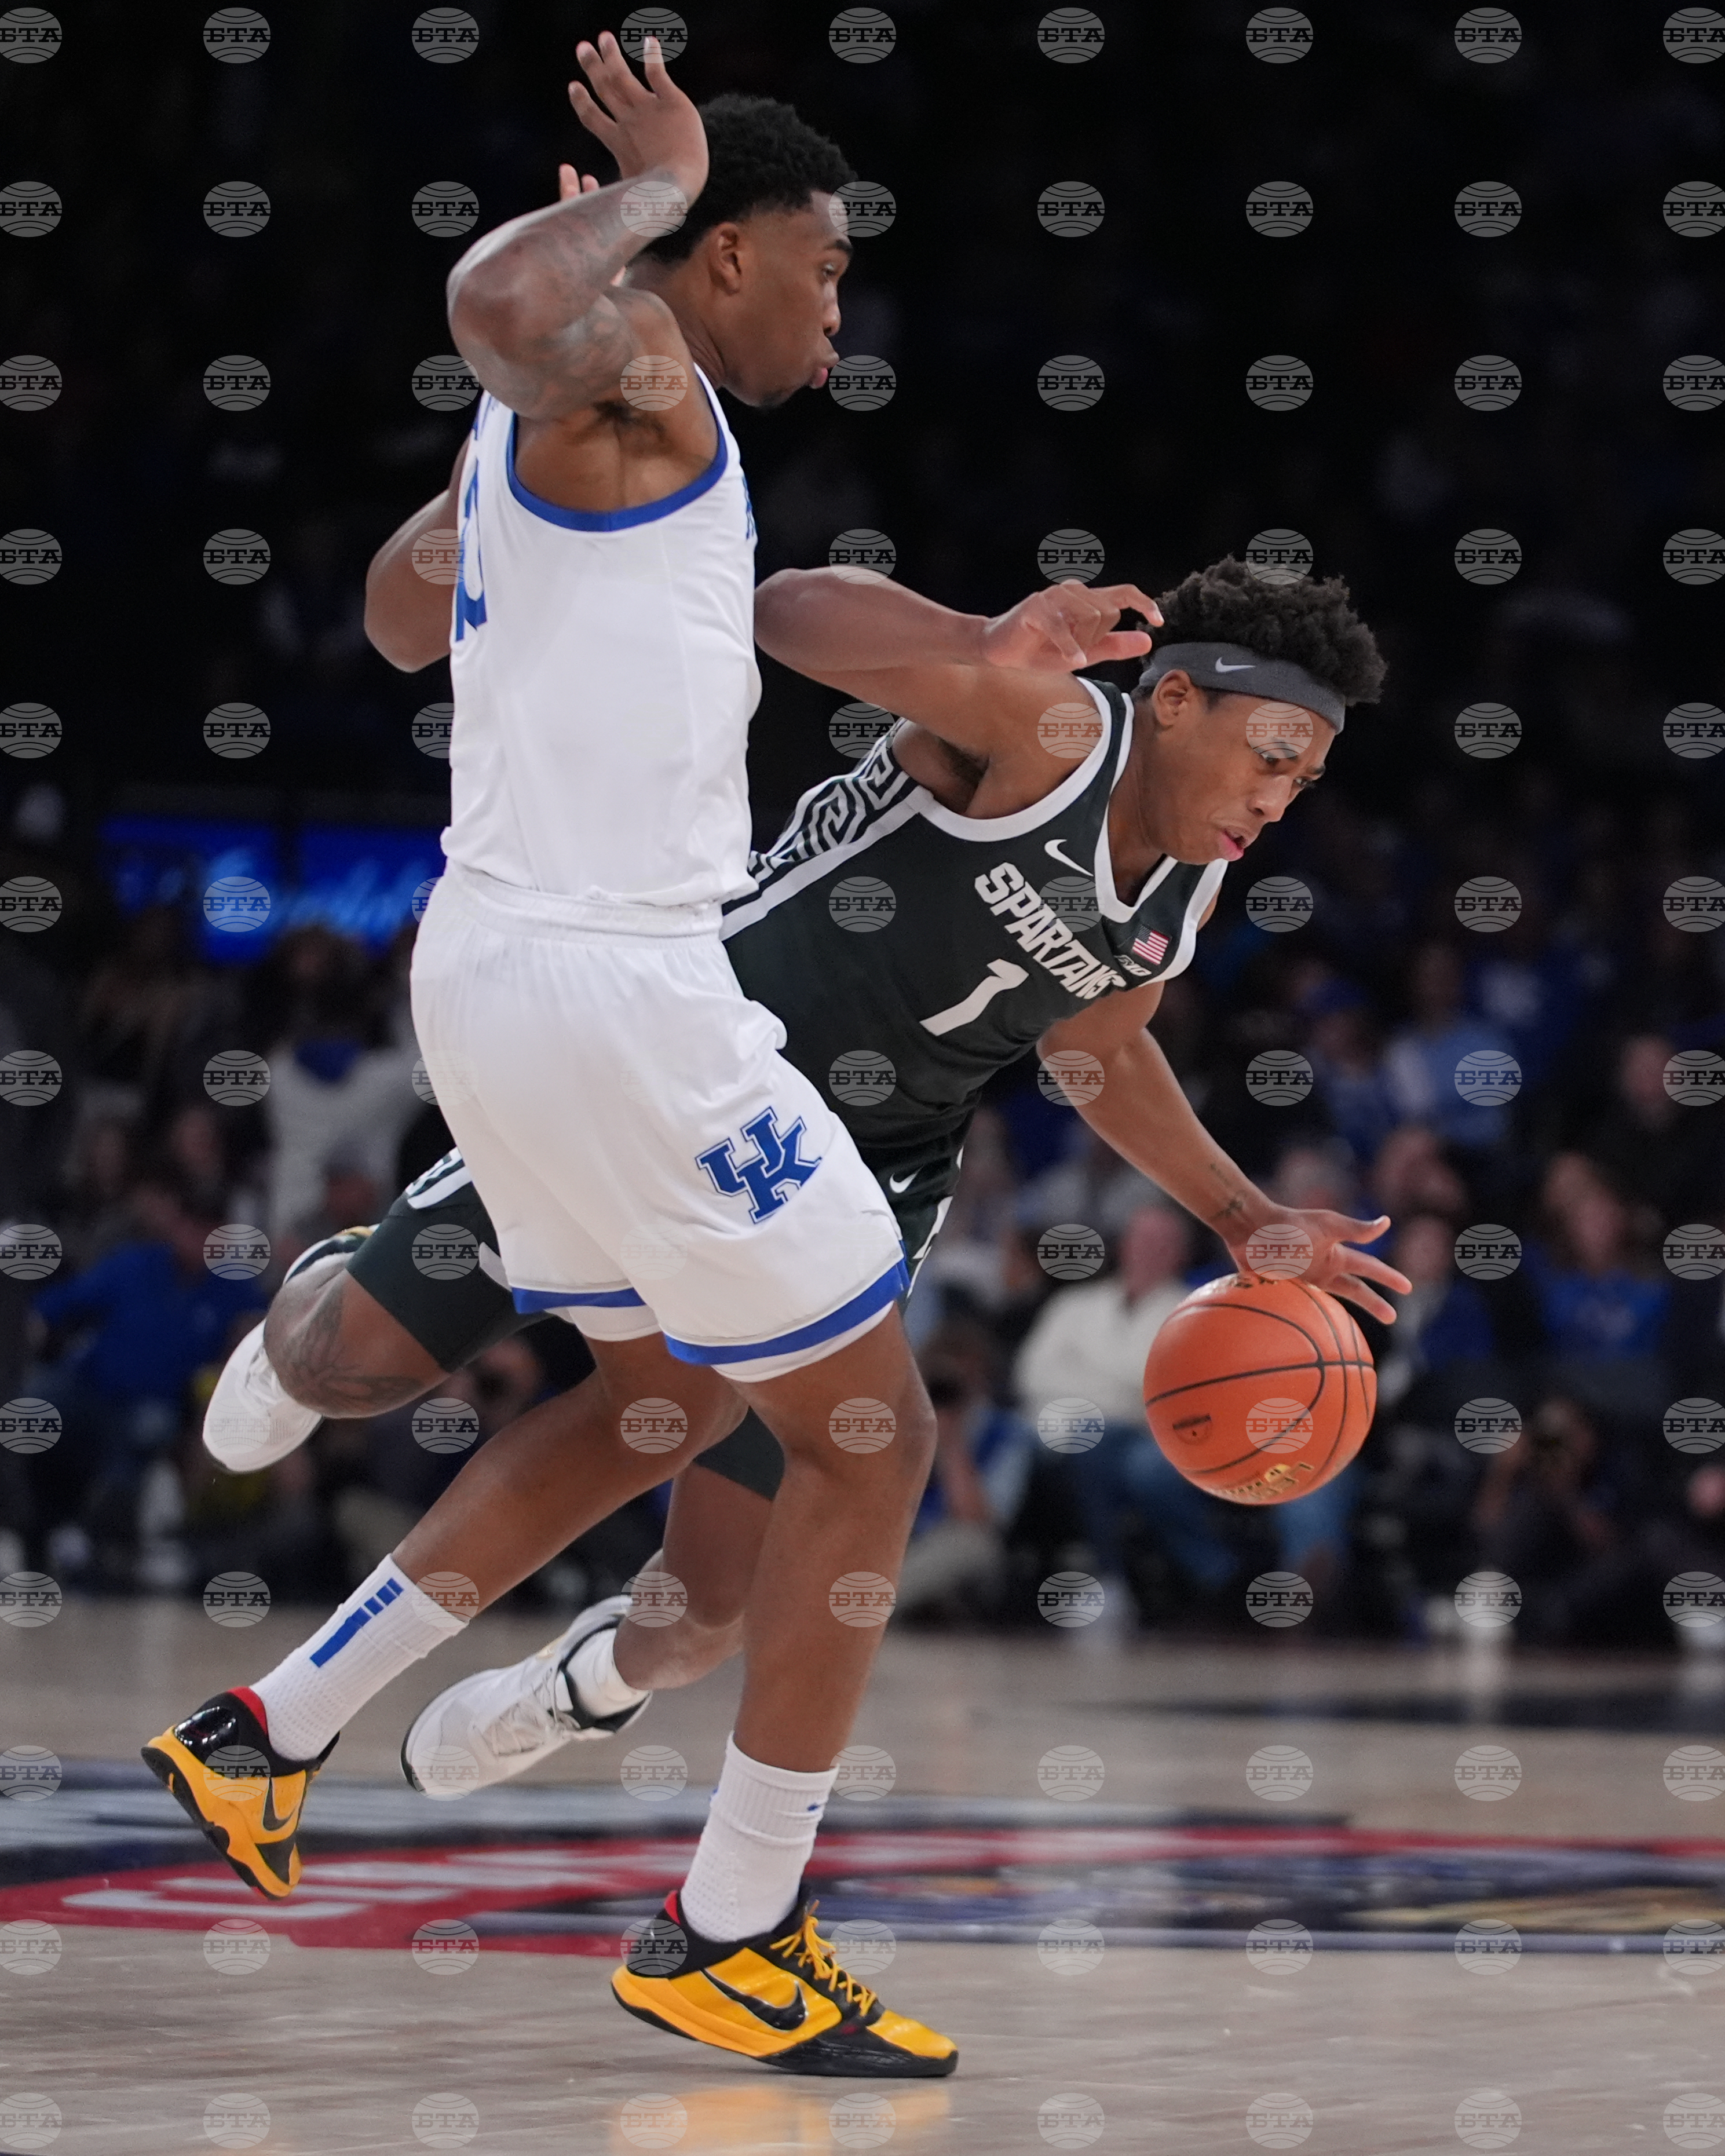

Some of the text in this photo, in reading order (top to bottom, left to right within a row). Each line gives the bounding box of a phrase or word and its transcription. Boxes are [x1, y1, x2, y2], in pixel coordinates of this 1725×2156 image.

[975, 862, 1127, 999] SPARTANS
[919, 959, 1029, 1036] 1
[695, 1106, 823, 1224] UK
